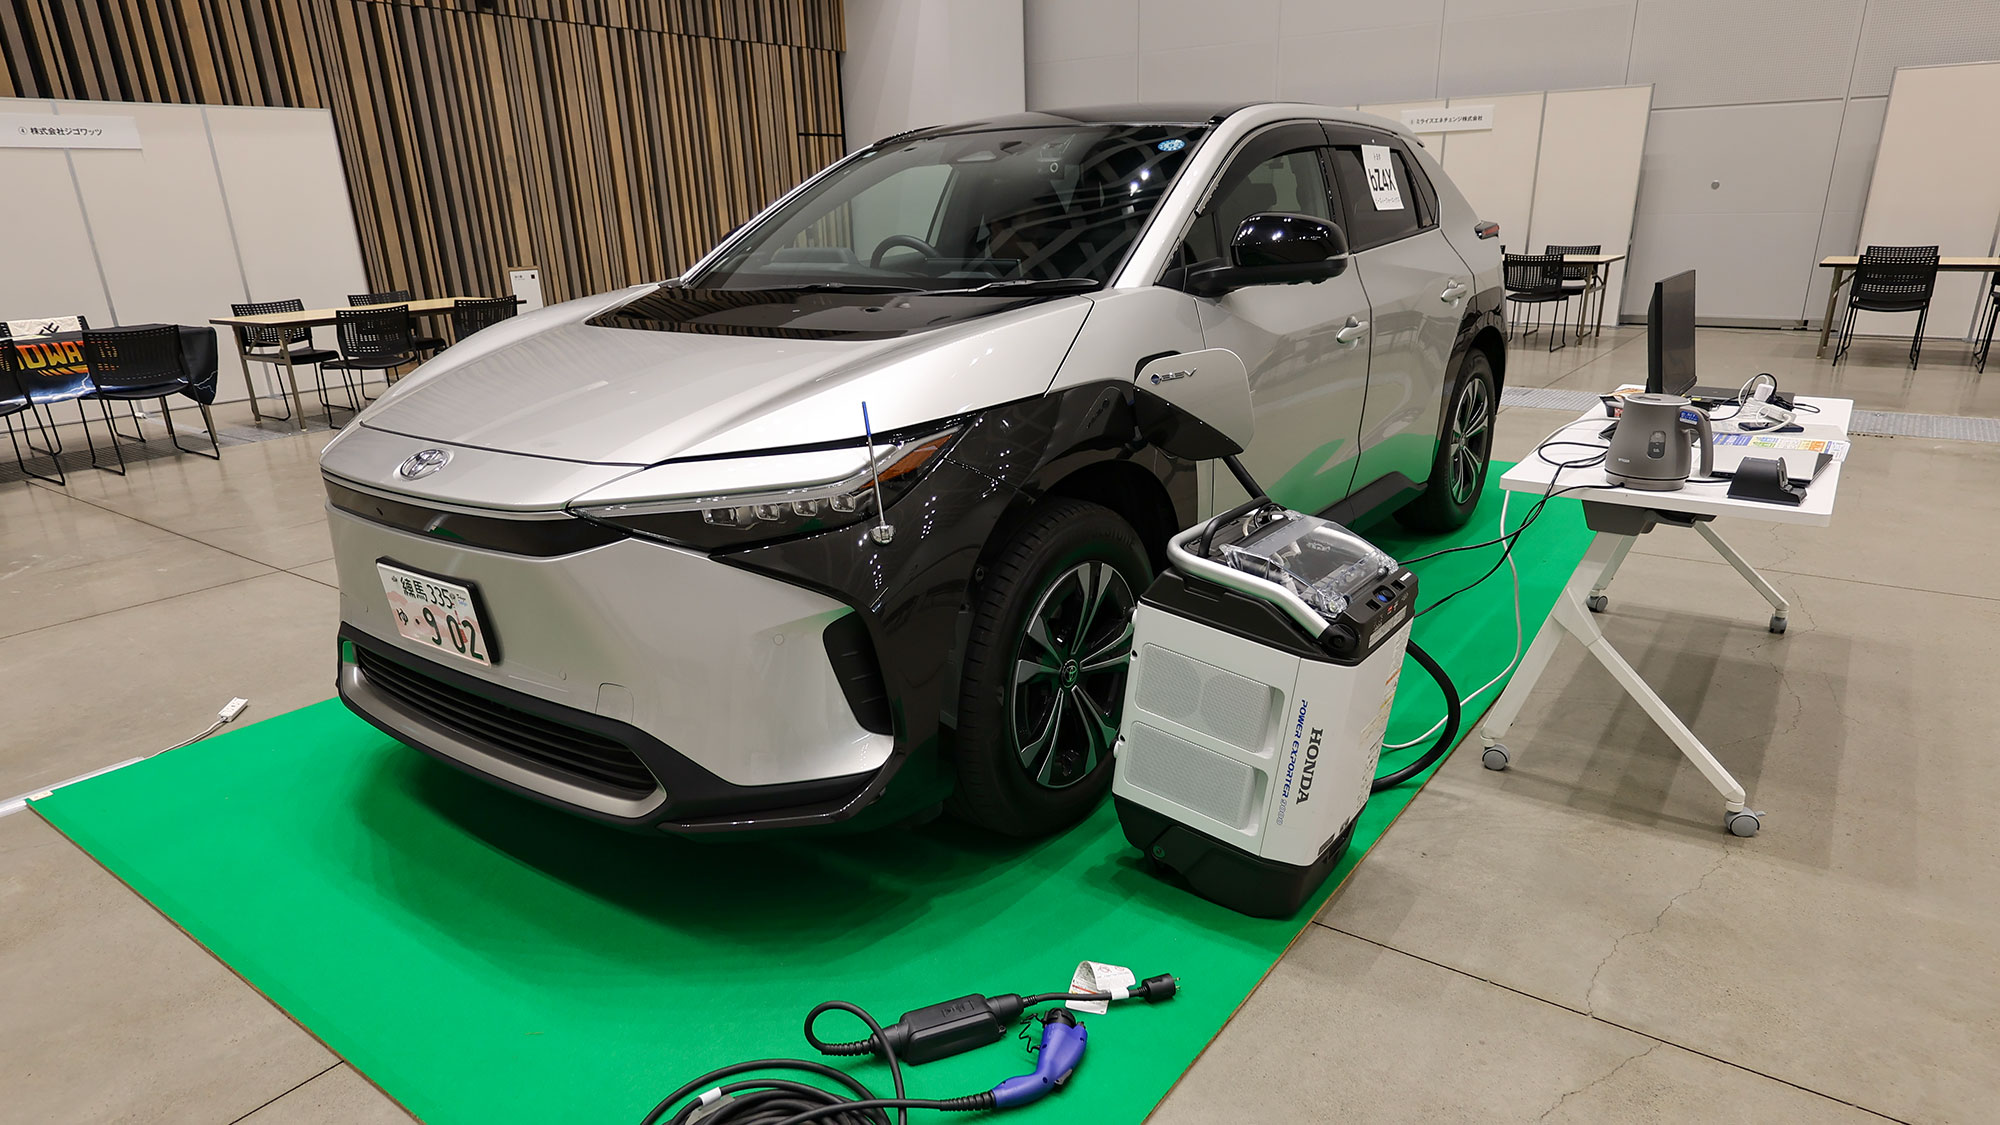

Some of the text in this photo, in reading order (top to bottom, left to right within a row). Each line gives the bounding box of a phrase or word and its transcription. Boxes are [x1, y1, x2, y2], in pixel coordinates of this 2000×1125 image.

[30, 127, 103, 136] 株式会社ジゴワッツ
[1367, 168, 1397, 191] bZ4X
[400, 577, 429, 602] 練馬
[426, 584, 453, 609] 335
[1294, 699, 1308, 739] POWER
[1282, 740, 1300, 798] EXPORTER
[1296, 727, 1324, 805] HONDA
